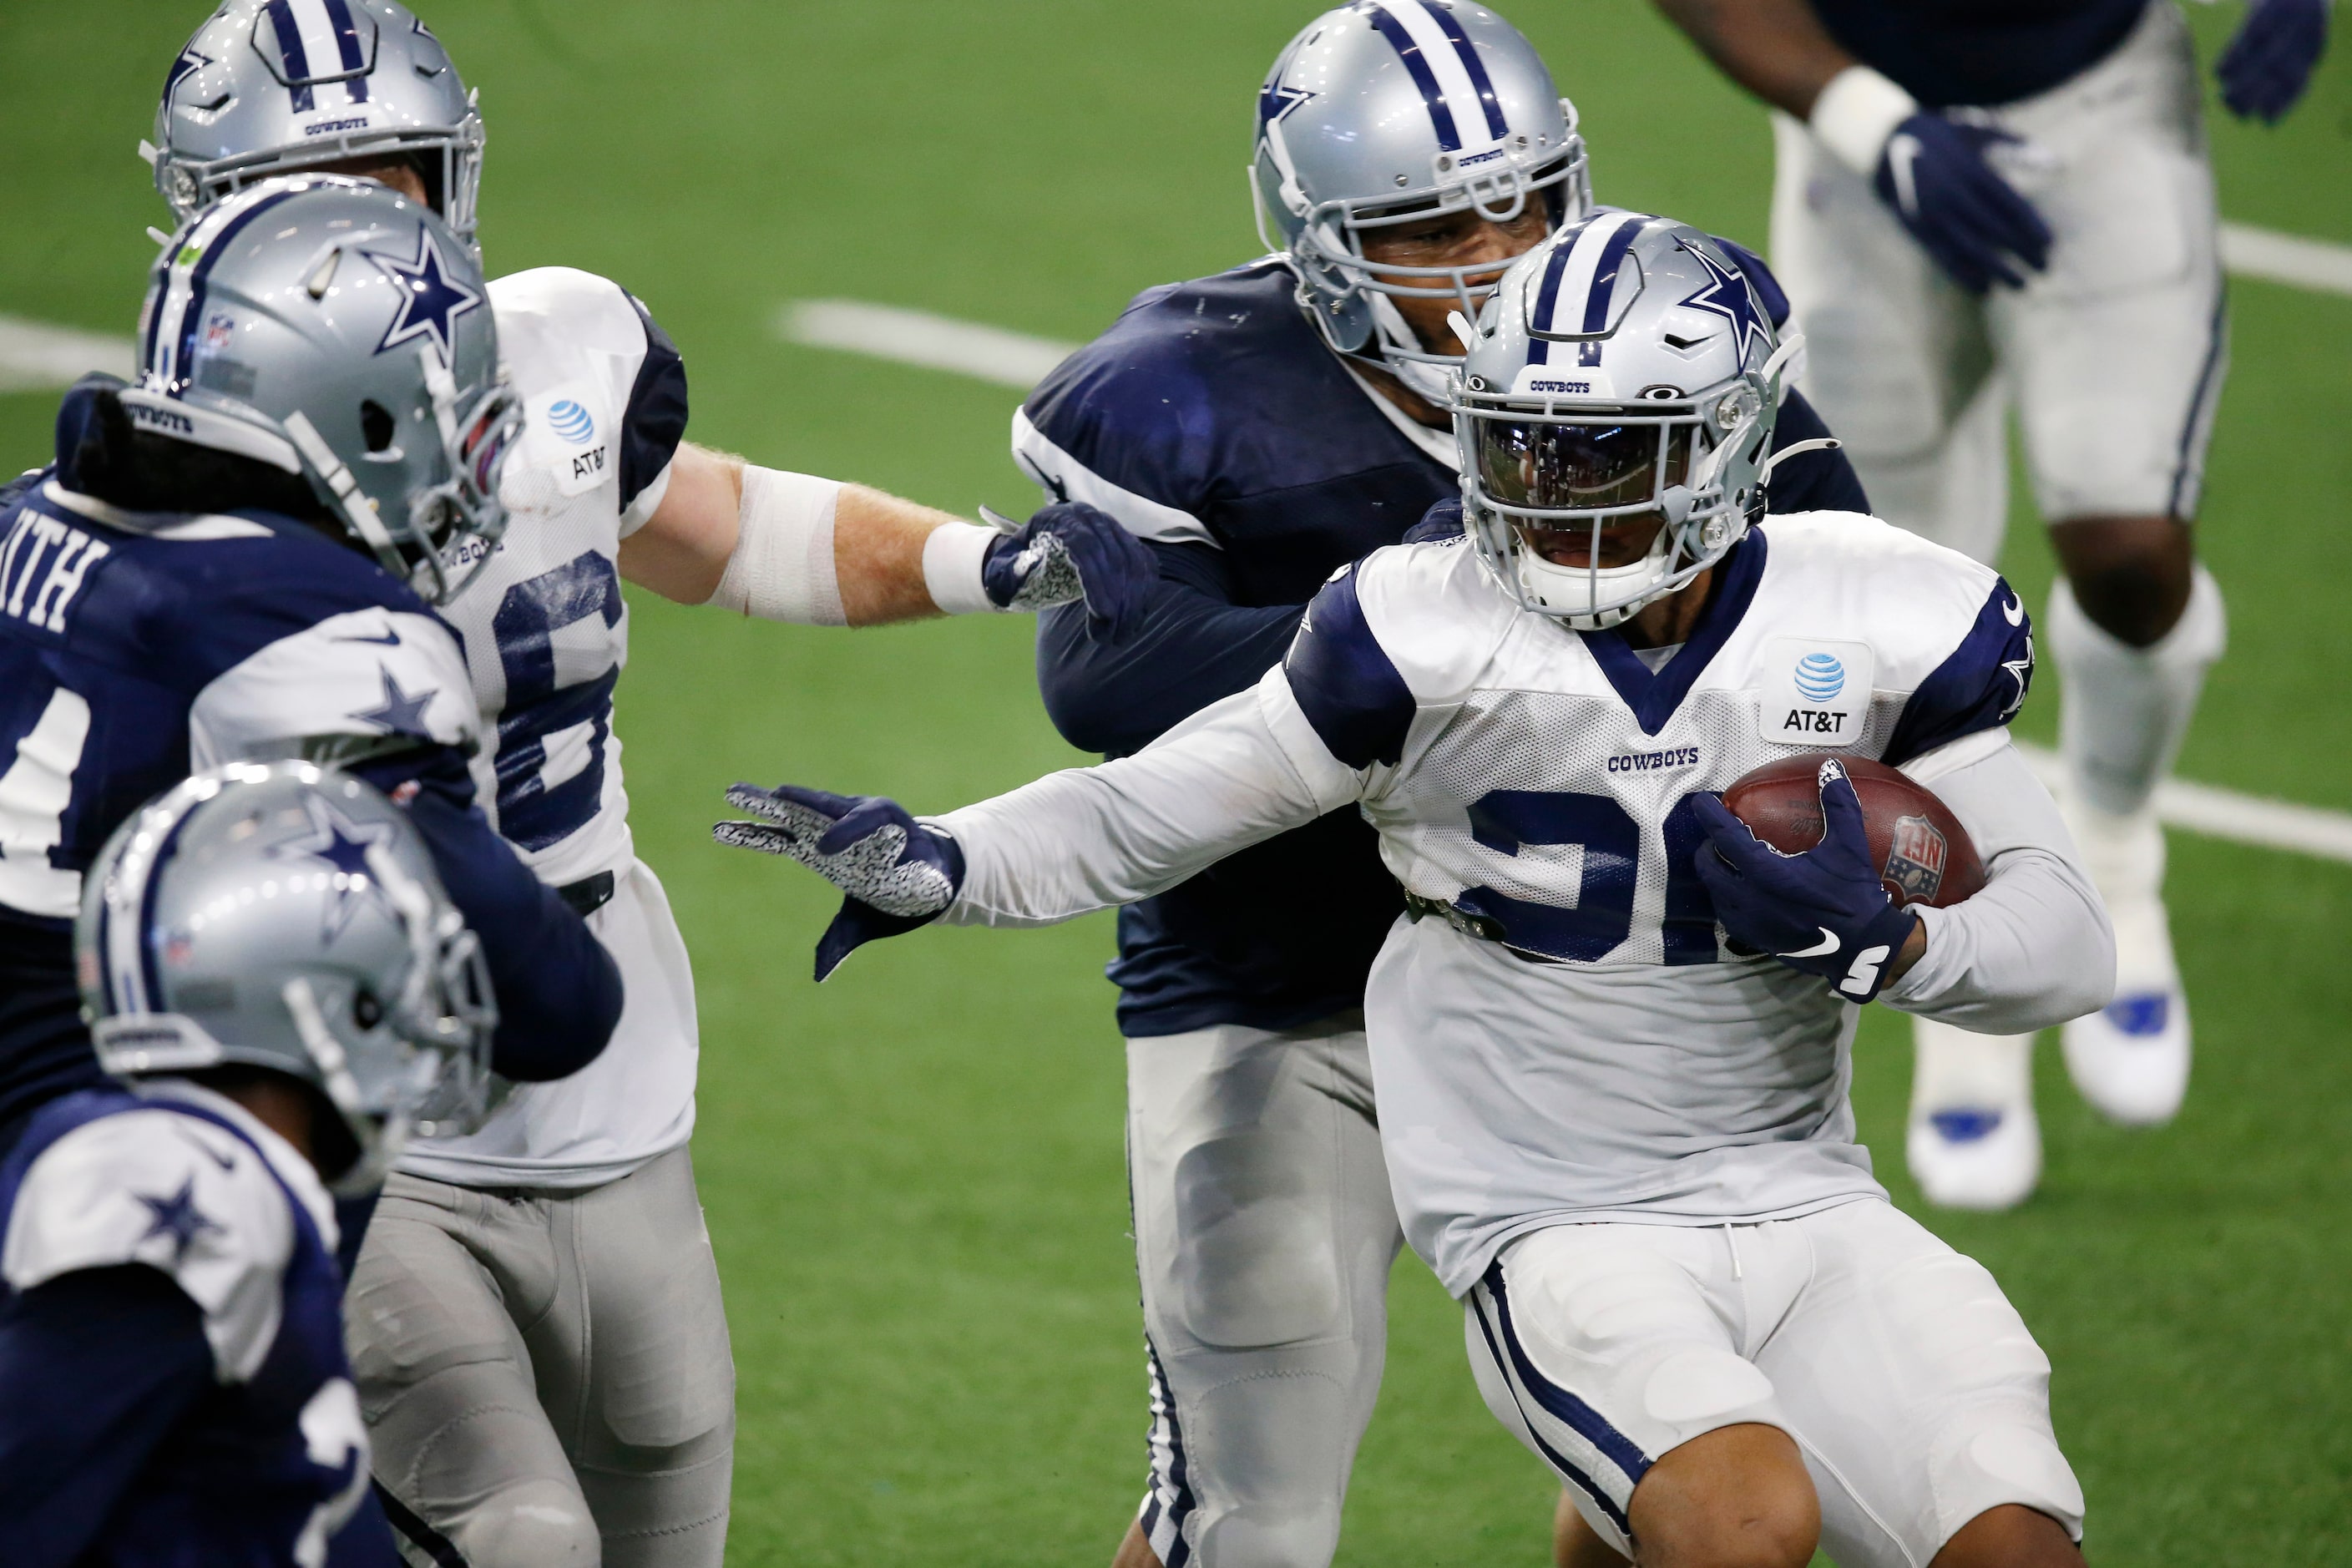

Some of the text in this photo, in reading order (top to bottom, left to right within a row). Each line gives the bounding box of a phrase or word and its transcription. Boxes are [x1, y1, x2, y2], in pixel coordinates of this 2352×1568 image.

[1530, 380, 1591, 393] COWBOYS
[1783, 710, 1848, 732] AT&T
[1608, 746, 1699, 771] COWBOYS
